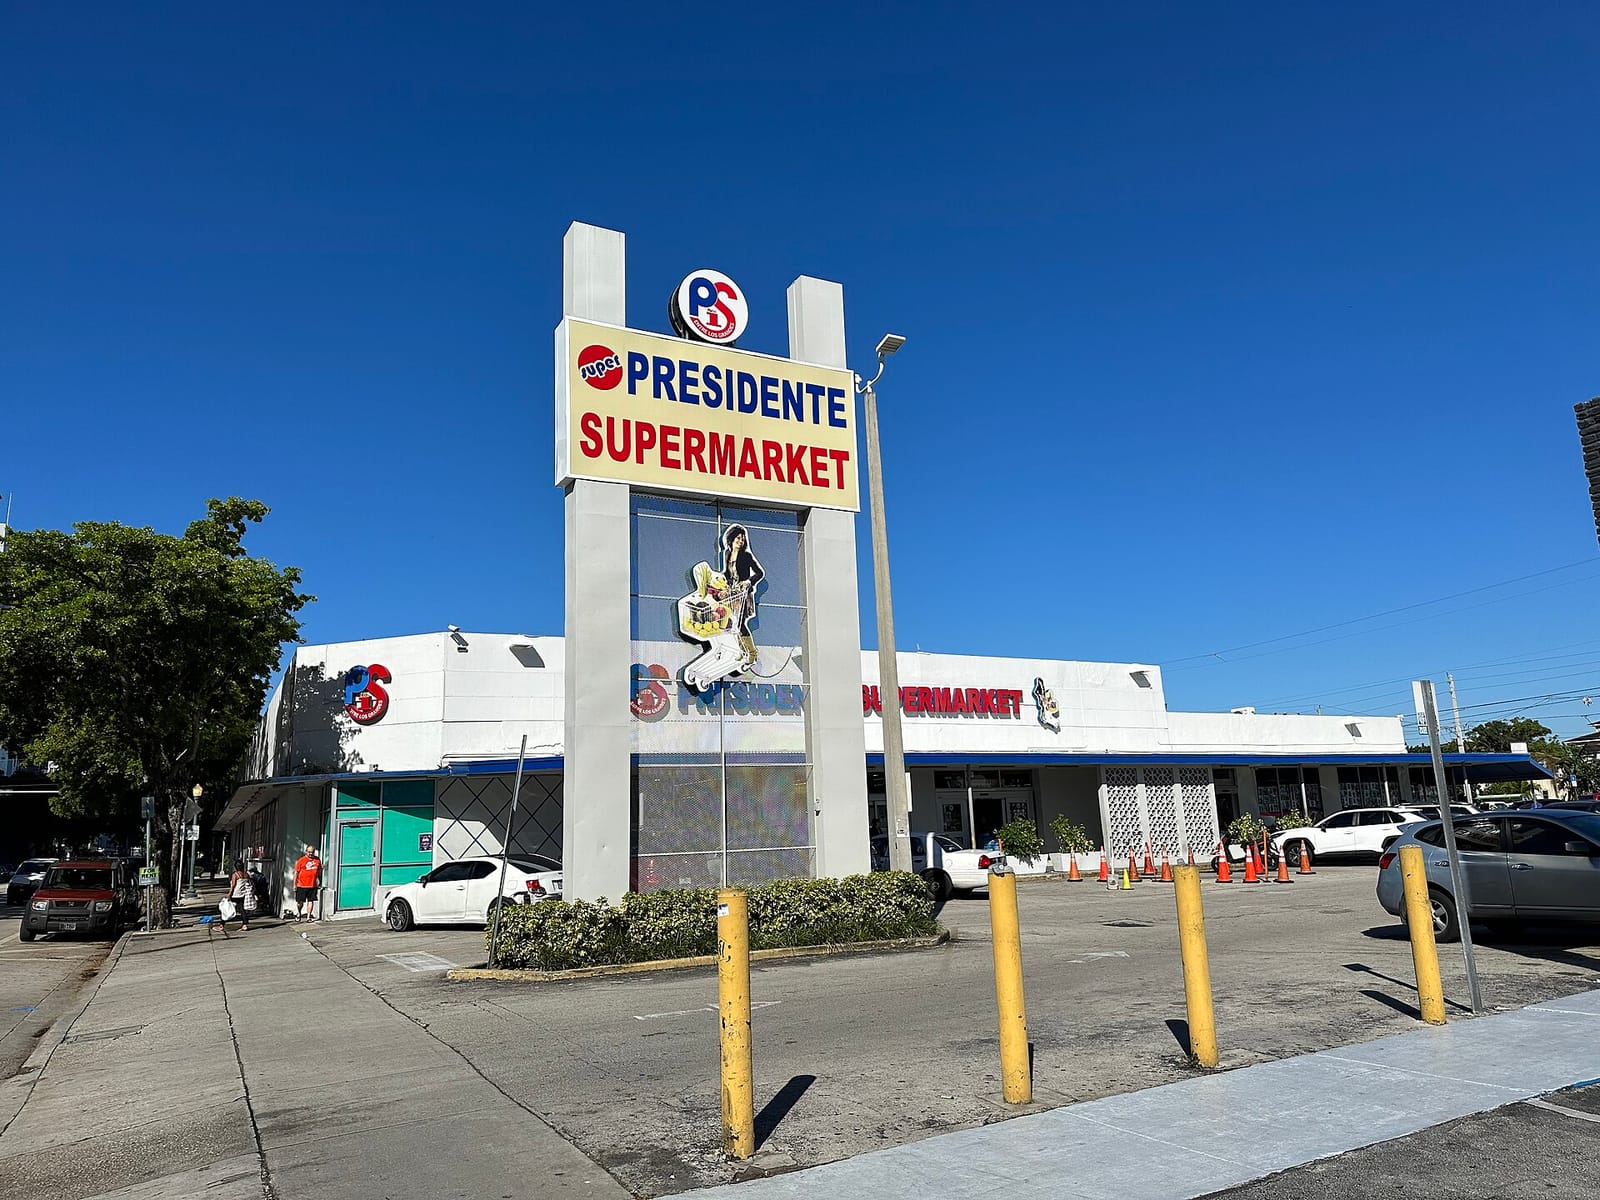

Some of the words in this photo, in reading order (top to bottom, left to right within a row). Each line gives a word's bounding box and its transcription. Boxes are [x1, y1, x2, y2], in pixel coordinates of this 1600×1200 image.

[581, 354, 621, 379] super
[627, 350, 848, 429] PRESIDENTE
[579, 412, 850, 490] SUPERMARKET
[862, 684, 1023, 718] SUERMARKET
